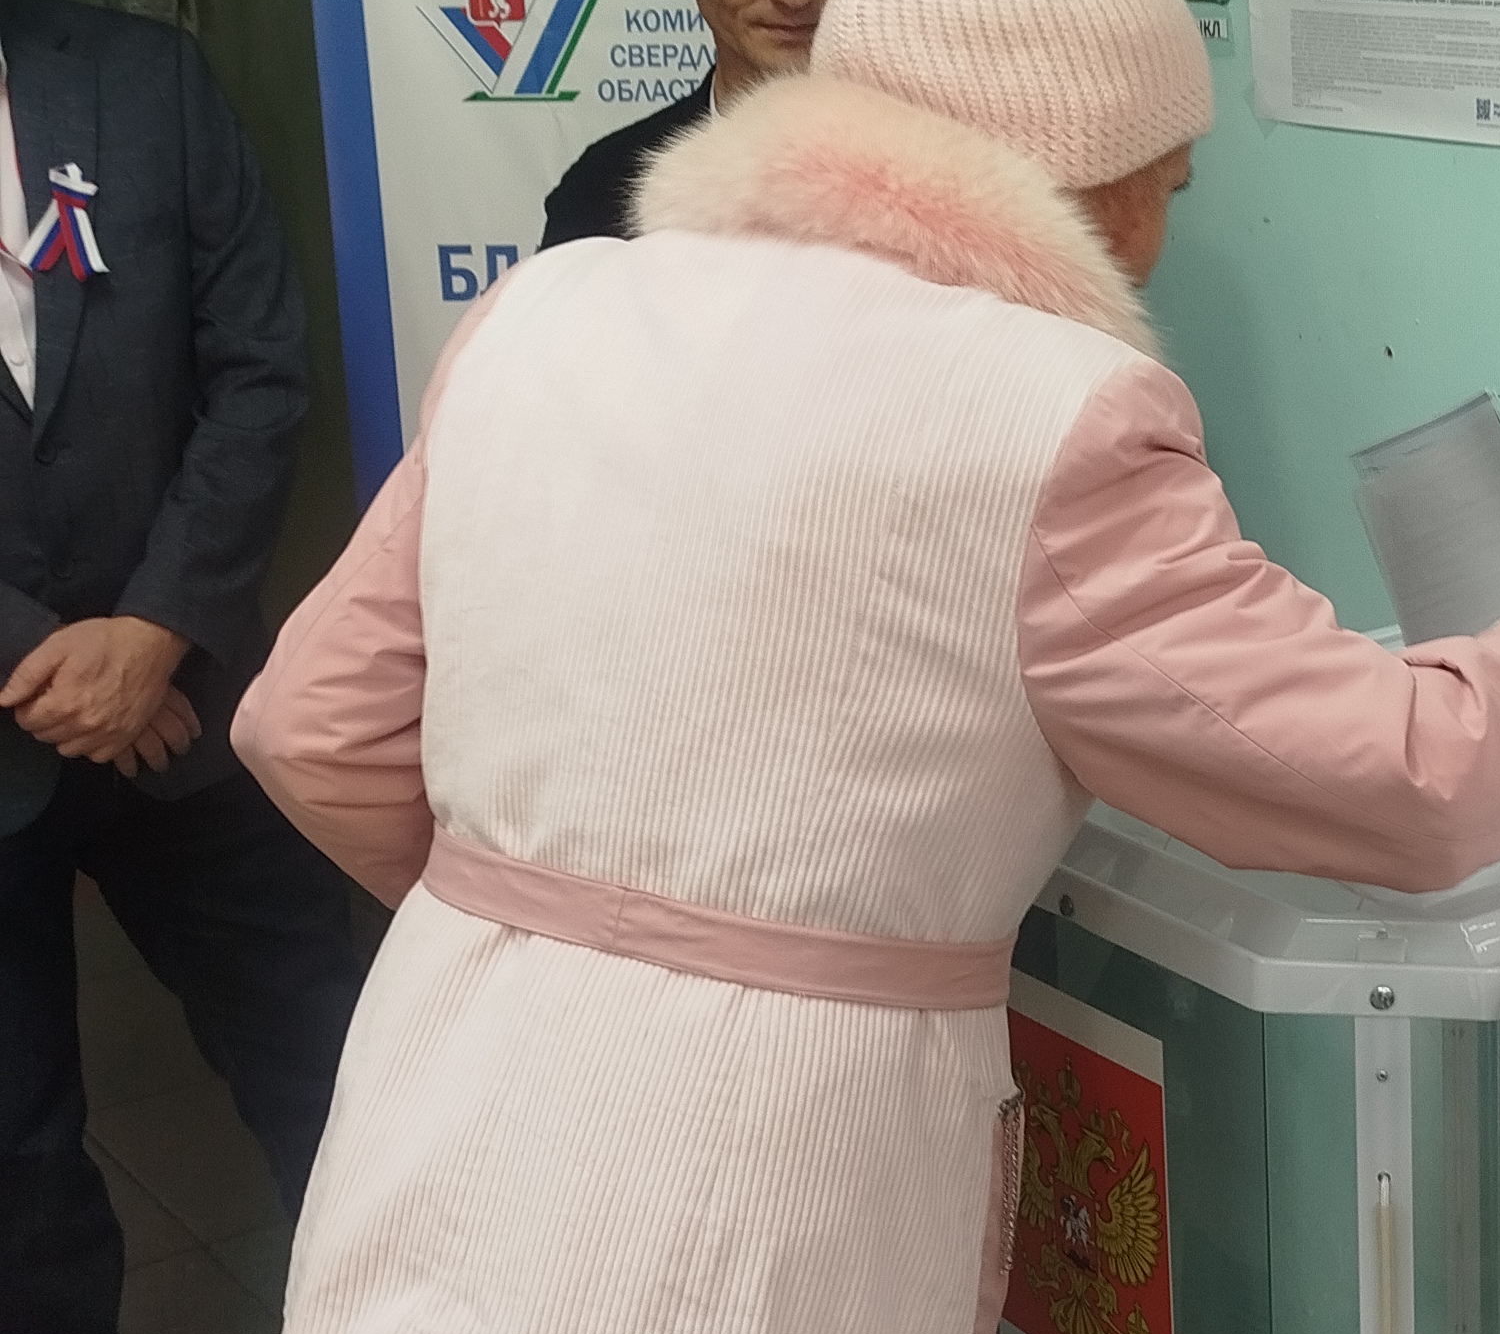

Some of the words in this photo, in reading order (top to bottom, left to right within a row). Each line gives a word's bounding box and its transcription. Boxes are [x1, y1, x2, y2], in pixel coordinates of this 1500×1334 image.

[625, 9, 705, 33] КОМИ
[1200, 20, 1221, 38] КЛ
[610, 43, 718, 71] СВЕРДЛ
[598, 79, 700, 102] ОБЛАСТ
